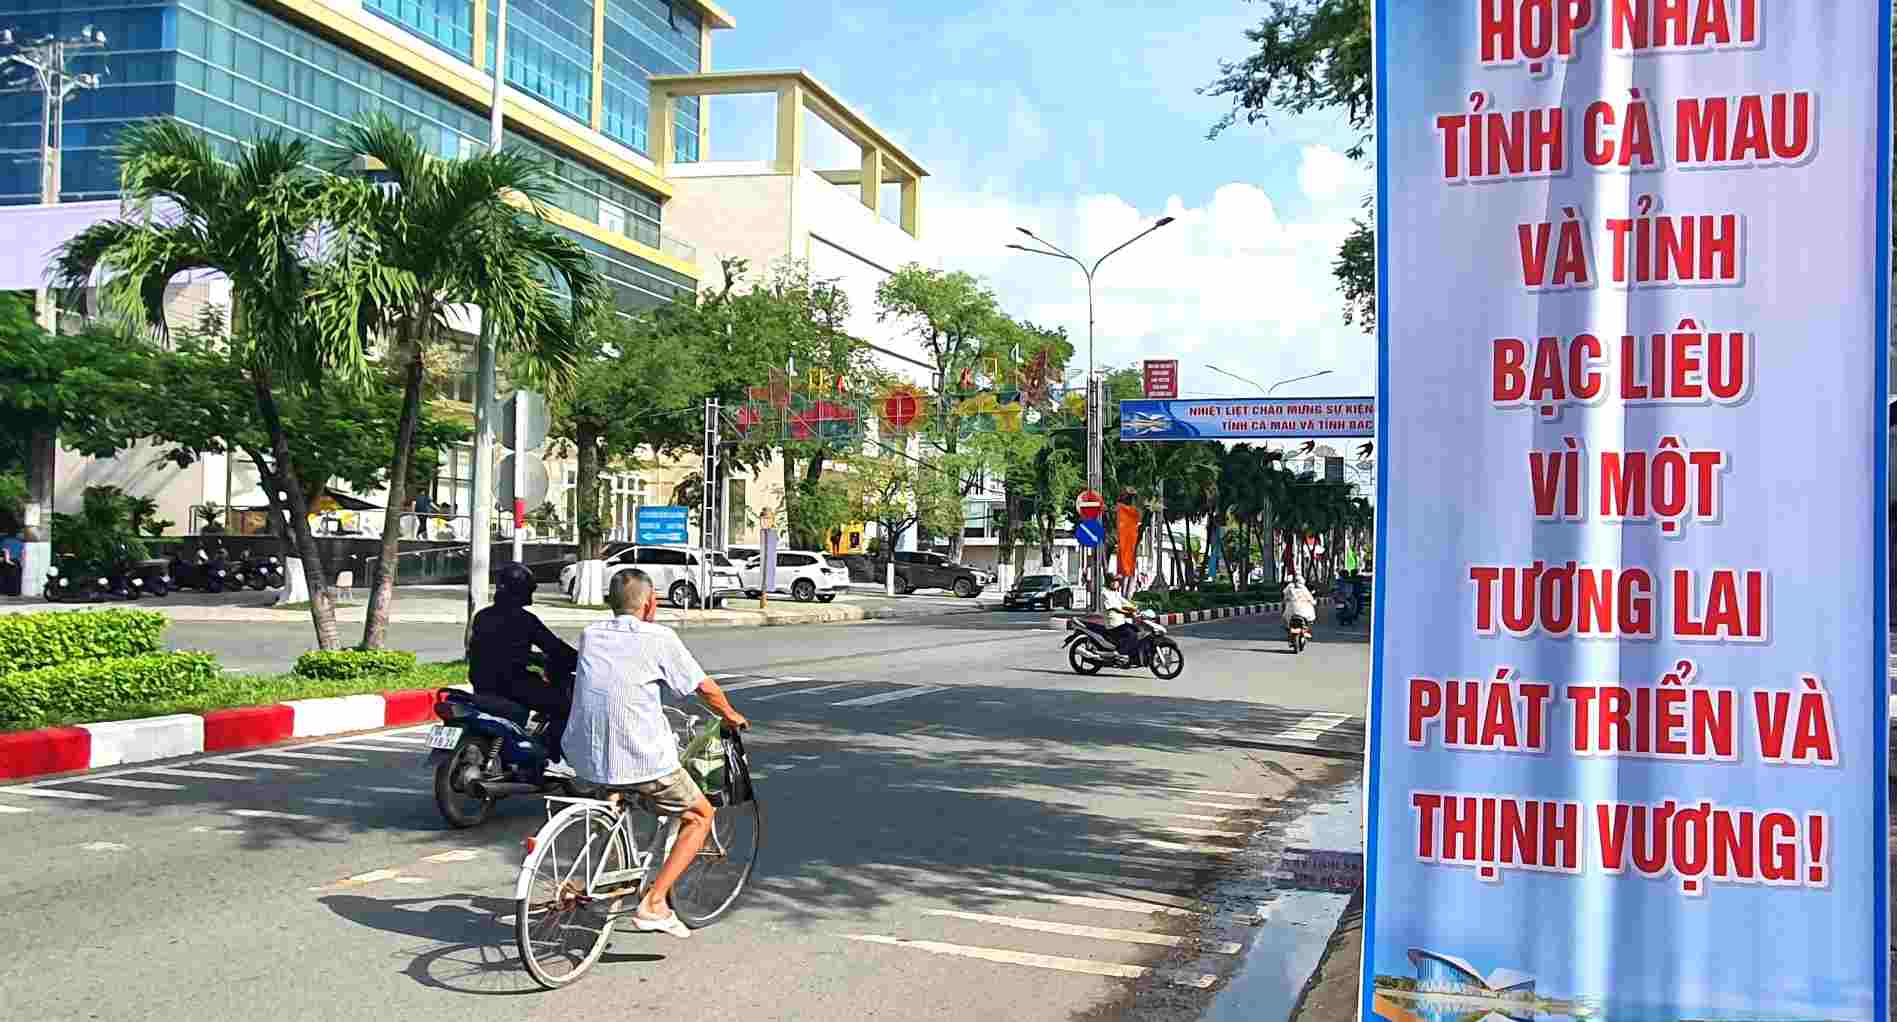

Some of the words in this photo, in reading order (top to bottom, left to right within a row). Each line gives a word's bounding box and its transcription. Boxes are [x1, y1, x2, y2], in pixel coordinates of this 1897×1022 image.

[1437, 91, 1563, 177] TỈNH
[1584, 88, 1654, 167] CÀ
[1676, 92, 1809, 162] MAU
[1519, 207, 1587, 286] VÀ
[1606, 195, 1735, 282] TỈNH
[1493, 335, 1601, 416] BẠC
[1620, 319, 1743, 400] LIÊU
[1529, 438, 1579, 516] VÌ
[1600, 437, 1721, 532] MỘT
[1470, 560, 1652, 634] TƯƠNG
[1674, 570, 1762, 637] LAI
[1409, 668, 1549, 748] PHÁT
[1568, 660, 1732, 757] TRIỂN
[1754, 678, 1833, 760] VÀ
[1413, 793, 1577, 877] THỊNH
